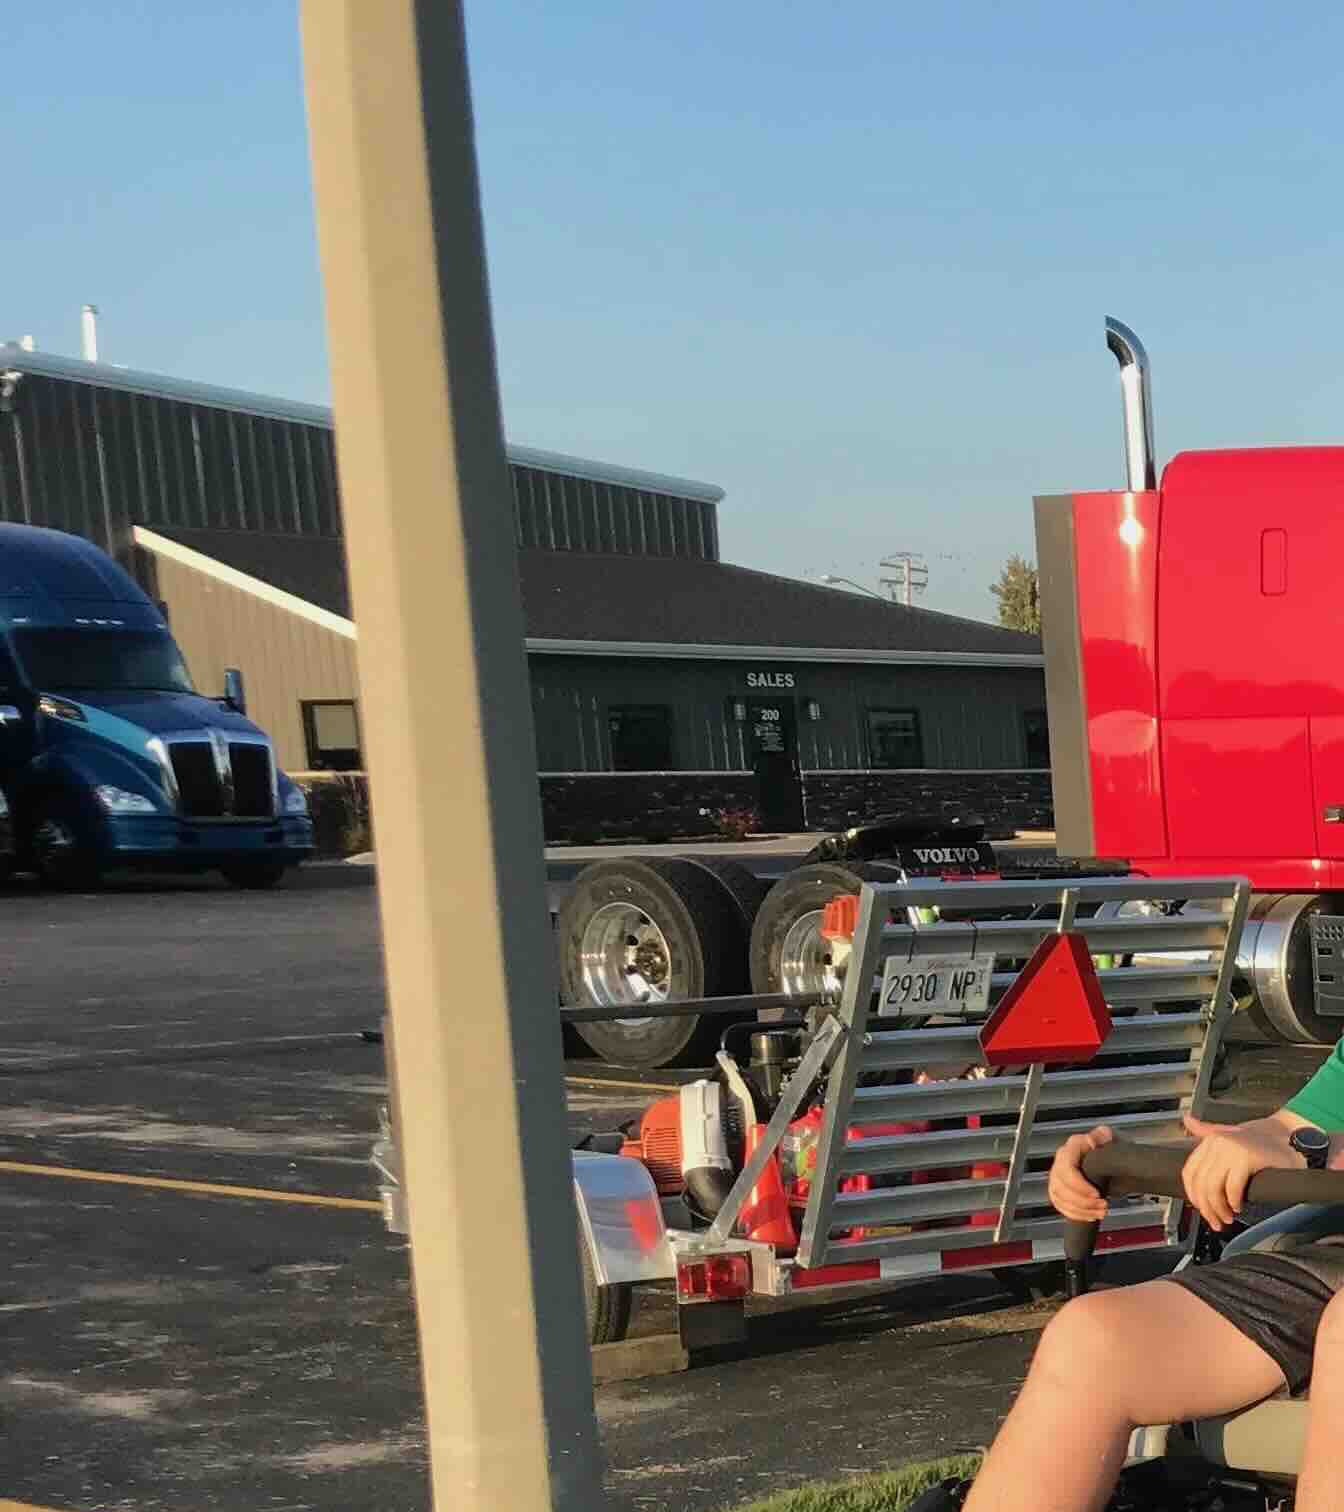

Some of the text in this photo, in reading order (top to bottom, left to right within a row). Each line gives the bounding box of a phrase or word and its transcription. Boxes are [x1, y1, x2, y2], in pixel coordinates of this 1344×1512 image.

[746, 672, 795, 688] SALES
[761, 709, 780, 721] 200
[913, 848, 980, 864] VOLVO
[886, 970, 976, 1004] 2930 NP
